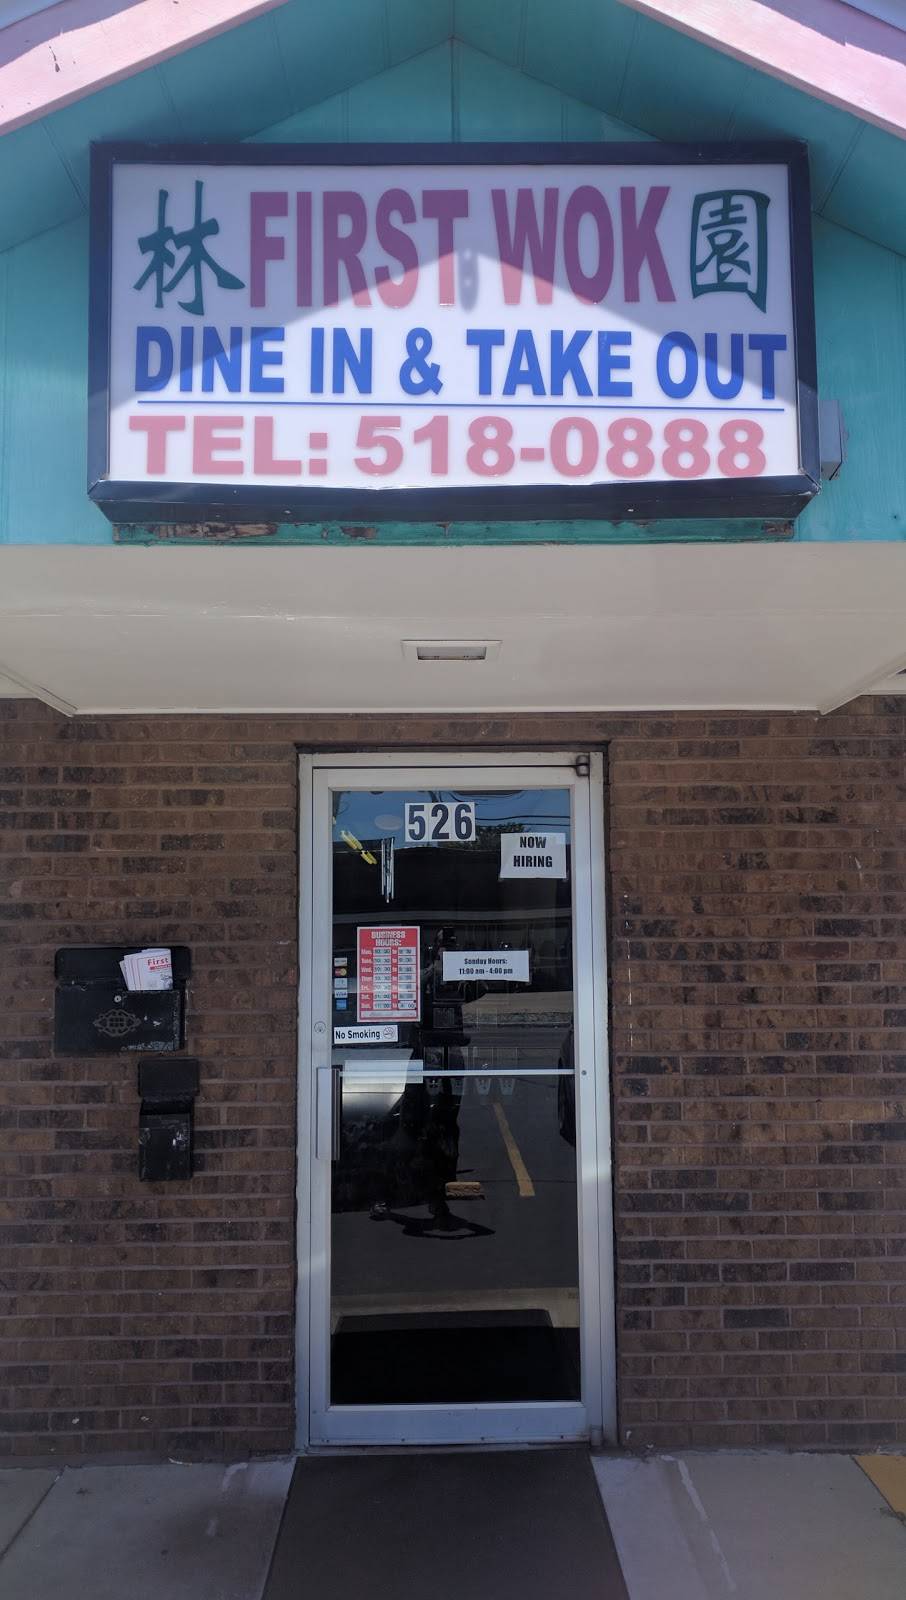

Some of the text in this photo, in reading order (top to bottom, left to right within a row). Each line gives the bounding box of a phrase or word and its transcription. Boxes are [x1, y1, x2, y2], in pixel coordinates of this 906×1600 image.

[133, 180, 245, 316] 林
[249, 185, 676, 309] FIRST WOK
[691, 188, 772, 314] 園
[134, 326, 787, 400] DINE IN & TAKE OUT
[129, 415, 767, 479] TEL: 518-0888
[408, 803, 473, 841] 526
[513, 855, 553, 868] HIRING
[519, 836, 547, 849] NOW
[371, 931, 406, 939] BUSINESS
[147, 957, 169, 966] First
[335, 1029, 381, 1040] No Smoking
